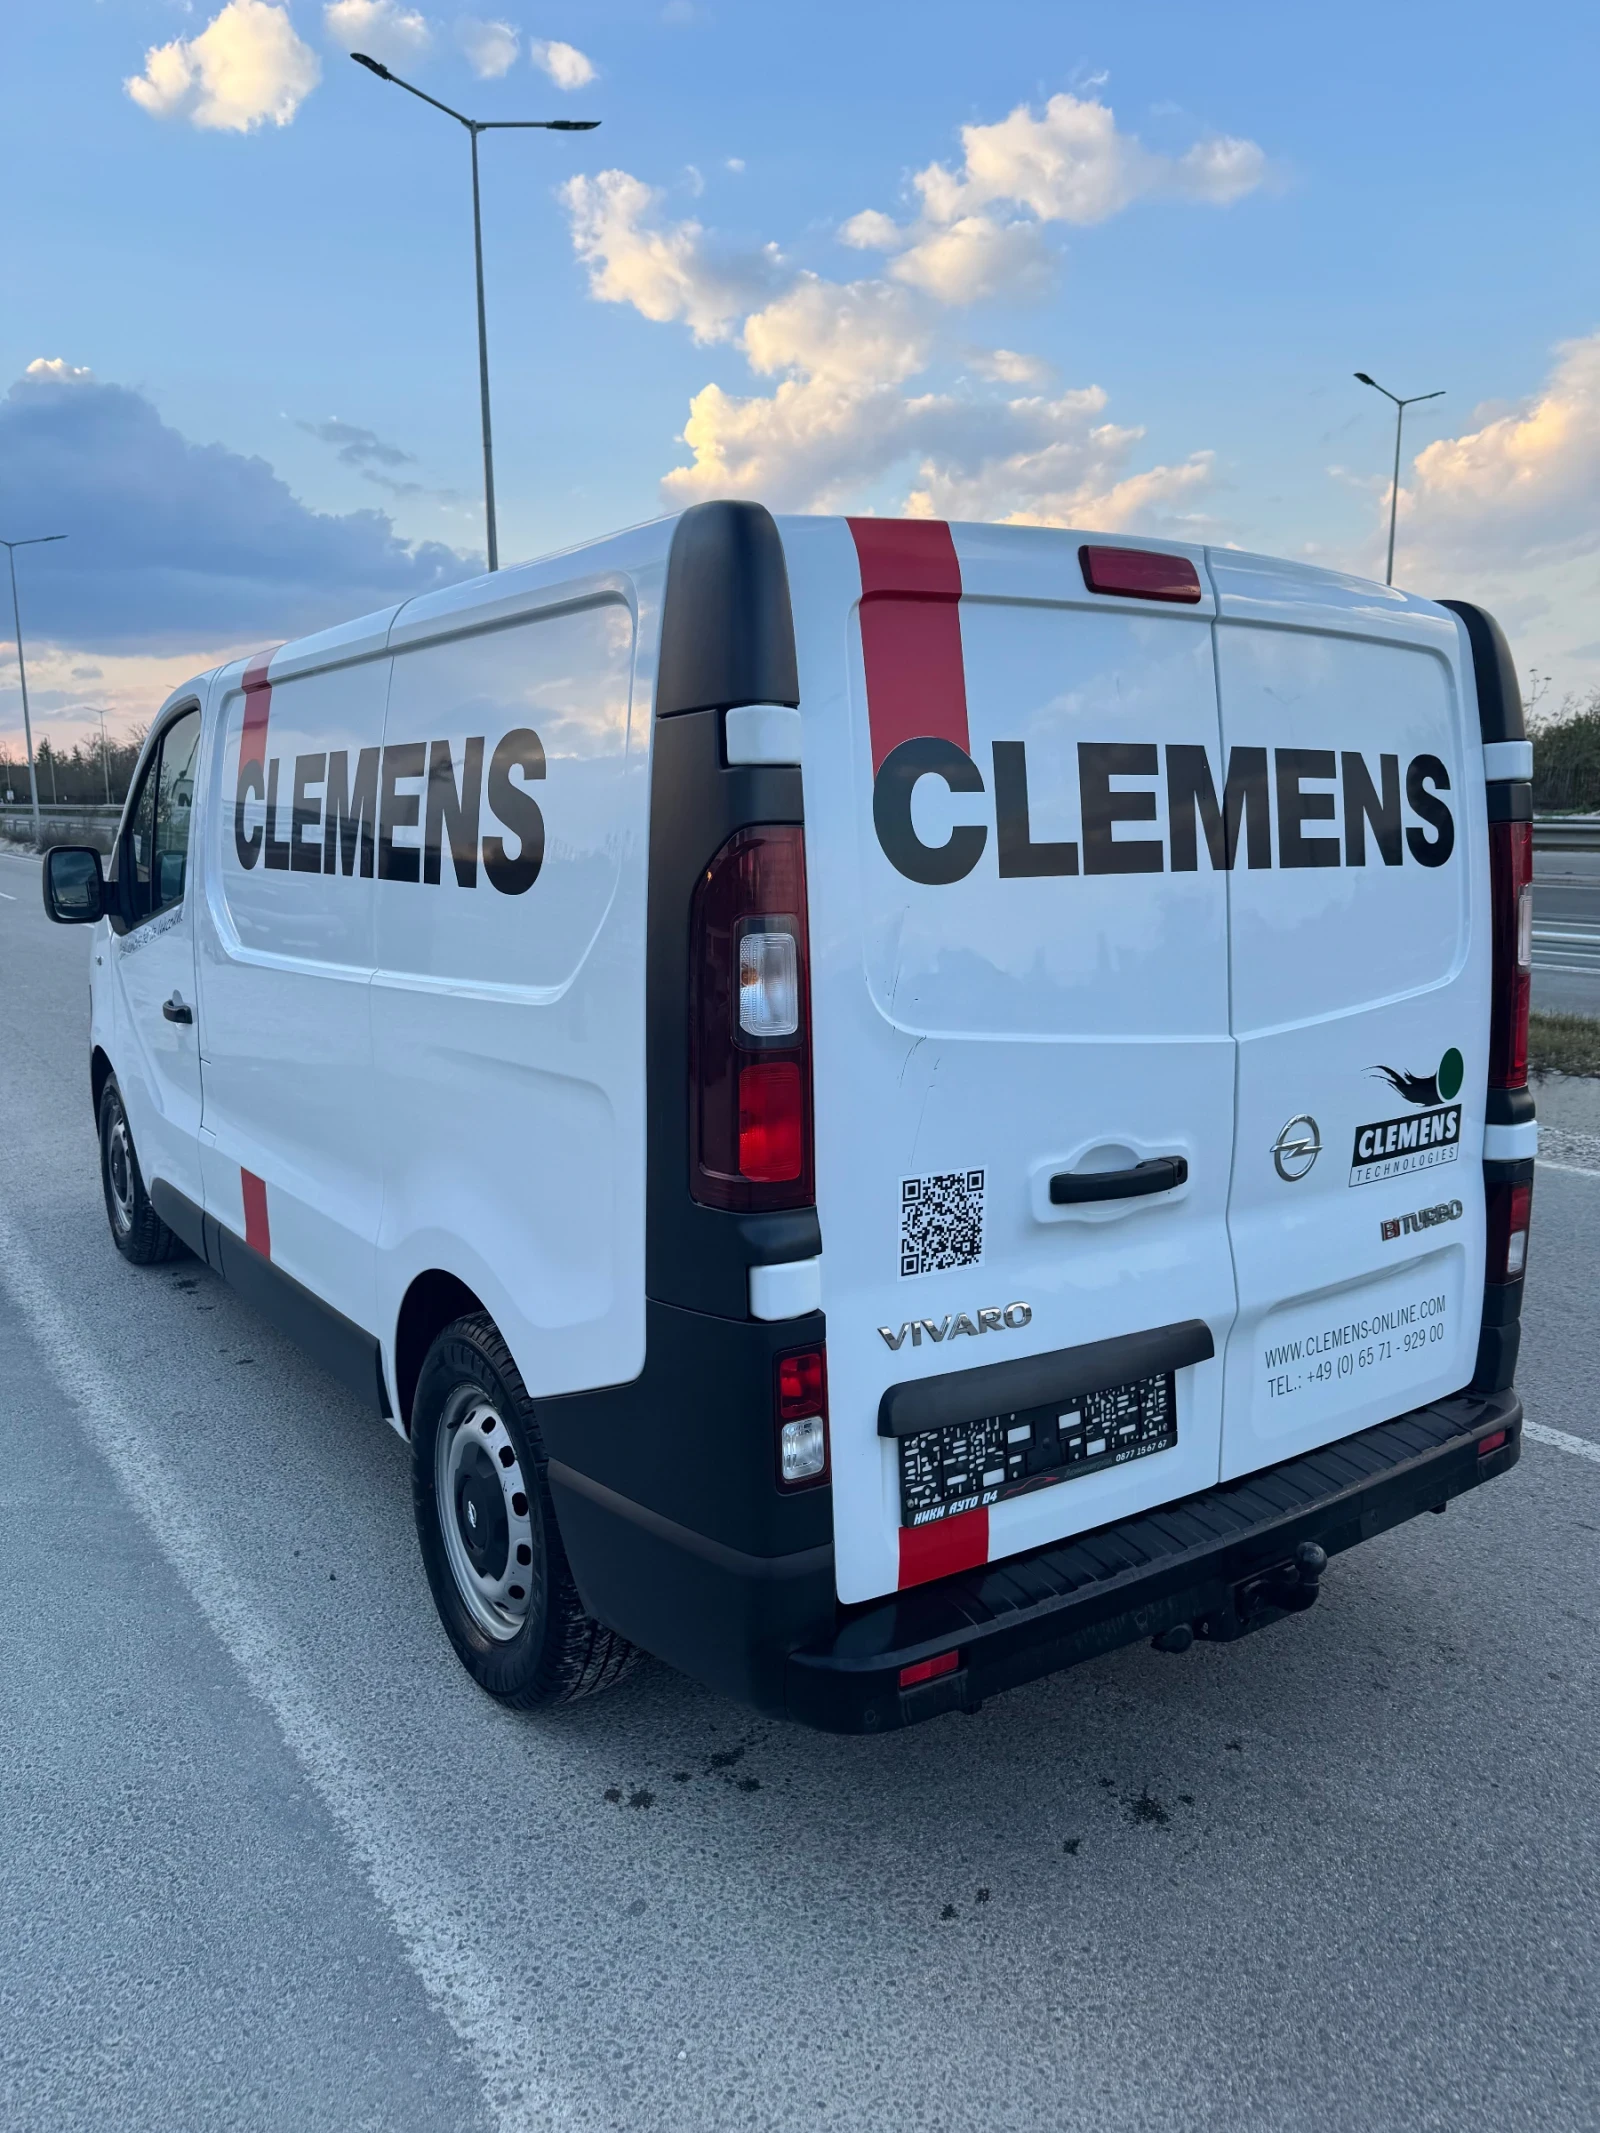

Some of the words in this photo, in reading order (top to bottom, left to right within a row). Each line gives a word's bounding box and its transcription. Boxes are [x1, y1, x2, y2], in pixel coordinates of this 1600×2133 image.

[235, 728, 547, 895] CLEMENS
[873, 736, 1455, 885] CLEMENS
[1358, 1110, 1458, 1158] CLEMENS
[1356, 1146, 1455, 1181] TECHNOLOGIES
[877, 1301, 1032, 1351] VIVARO
[1264, 1295, 1446, 1369] WWW.CLEMENS-ONLINE.COM
[1268, 1374, 1302, 1398] TEL.:
[1307, 1361, 1332, 1383] +49
[1337, 1353, 1354, 1379] (0)
[1358, 1347, 1374, 1368] 65
[1379, 1341, 1392, 1361] 71
[1404, 1329, 1426, 1352] 929
[1429, 1322, 1444, 1343] 00
[1115, 1449, 1135, 1462] 0877
[913, 1505, 946, 1526] НИКИ
[948, 1495, 980, 1515] АУТО
